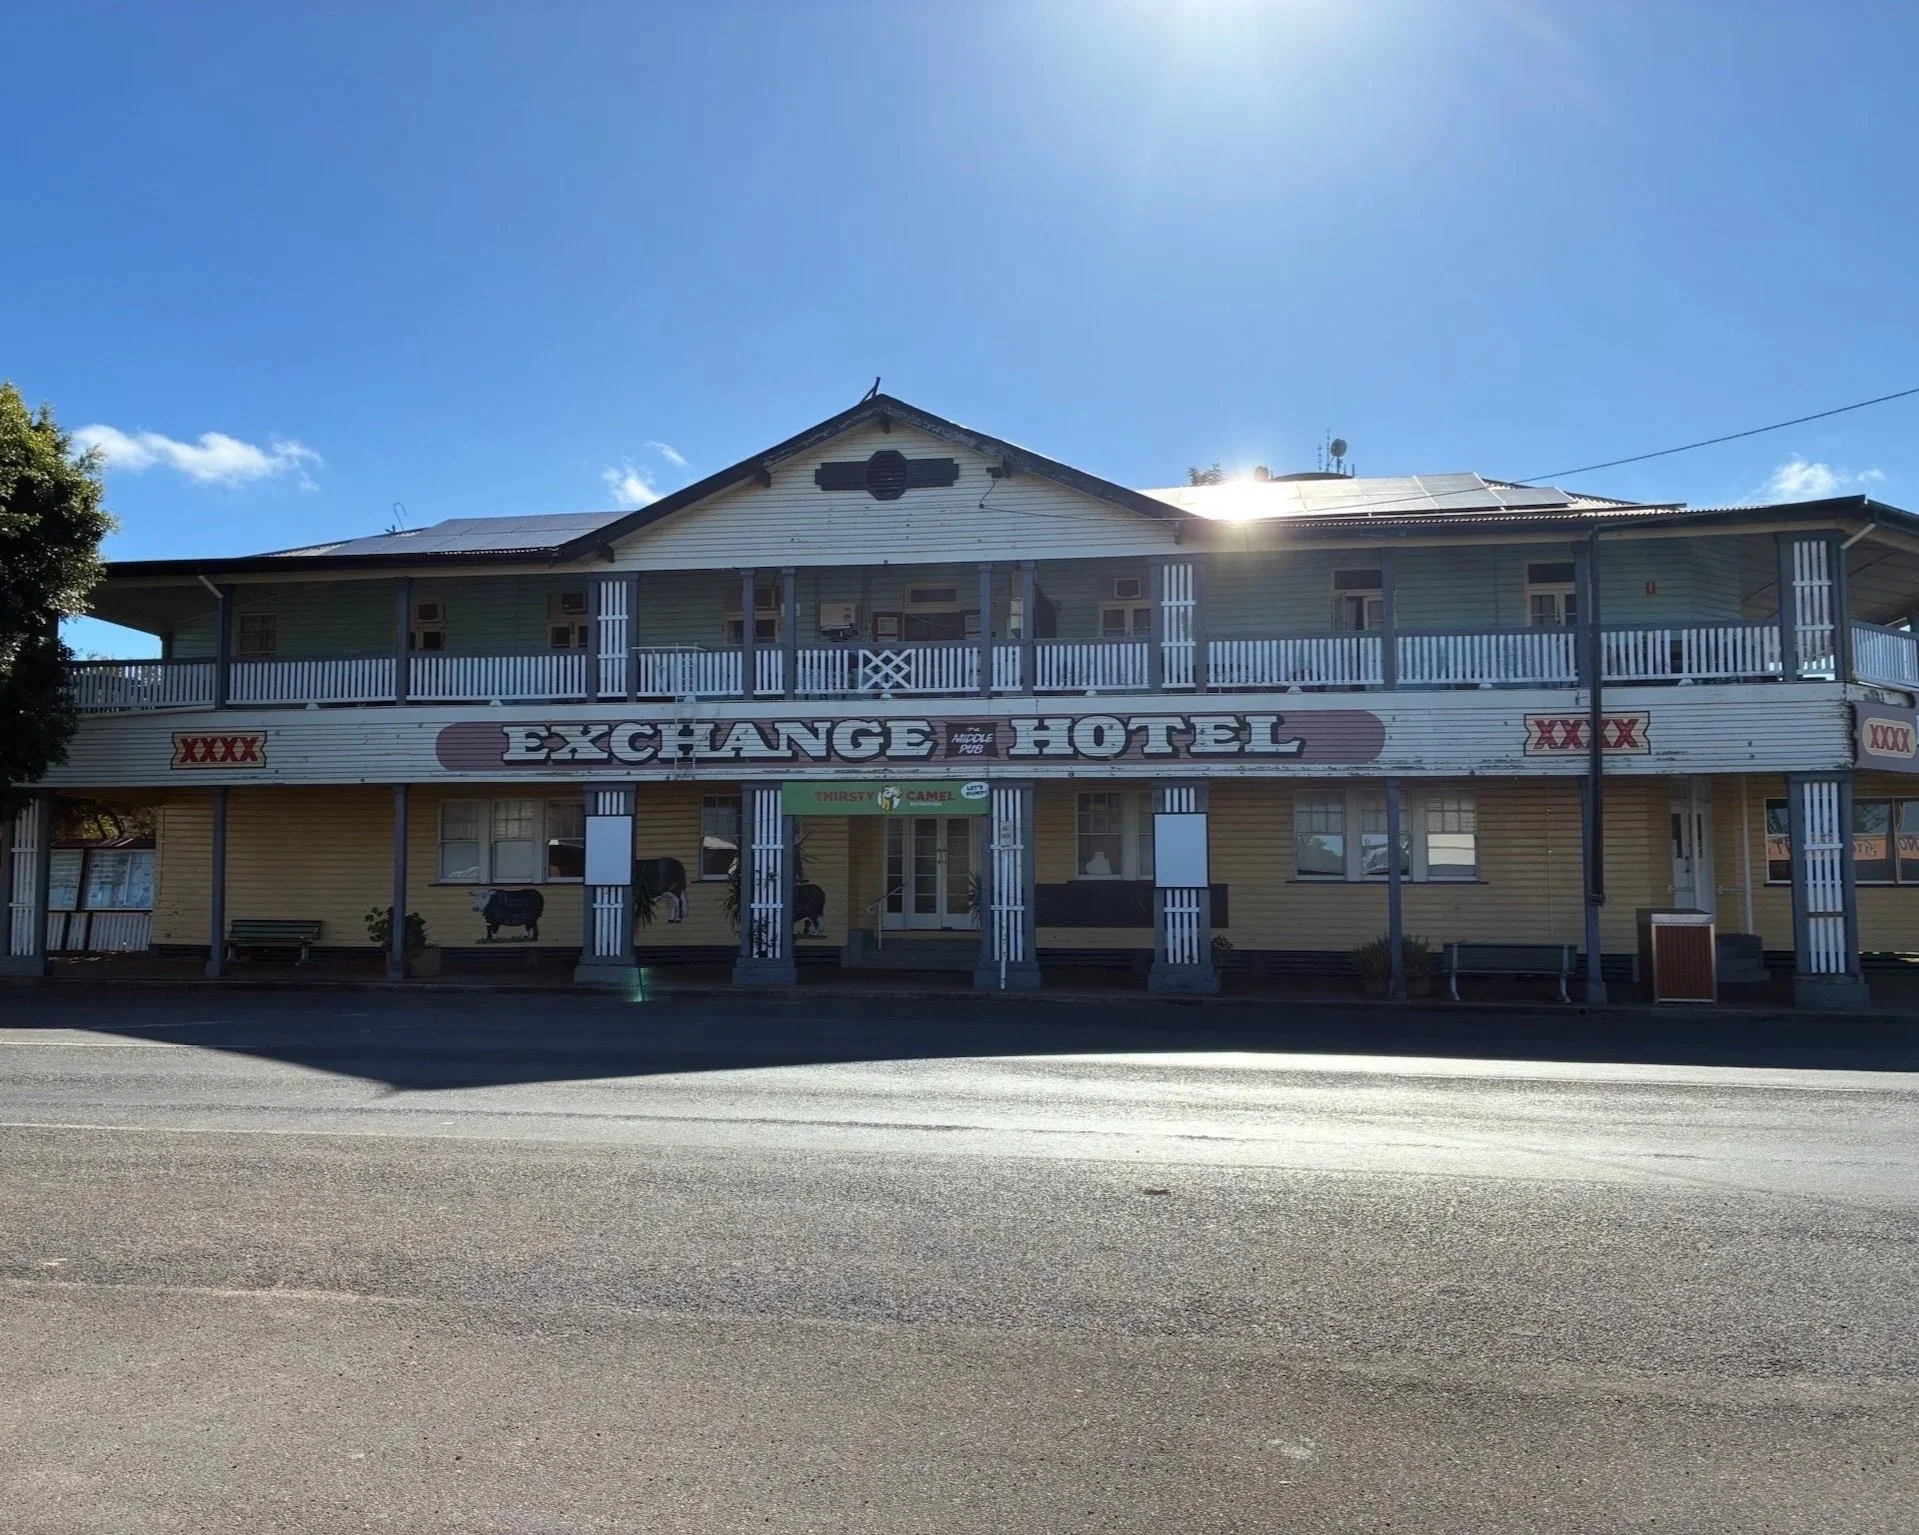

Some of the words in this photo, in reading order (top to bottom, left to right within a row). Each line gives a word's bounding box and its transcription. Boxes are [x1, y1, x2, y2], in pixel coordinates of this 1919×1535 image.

[502, 718, 937, 763] EXCHANGE
[1007, 714, 1305, 760] HOTEL
[952, 733, 994, 743] MIDDLE
[1532, 718, 1640, 749] XXXX
[1869, 723, 1911, 753] XXXX
[180, 736, 260, 762] XXXX
[959, 744, 984, 754] PUB
[815, 790, 873, 802] THIRSTY
[906, 790, 955, 801] CAMEL
